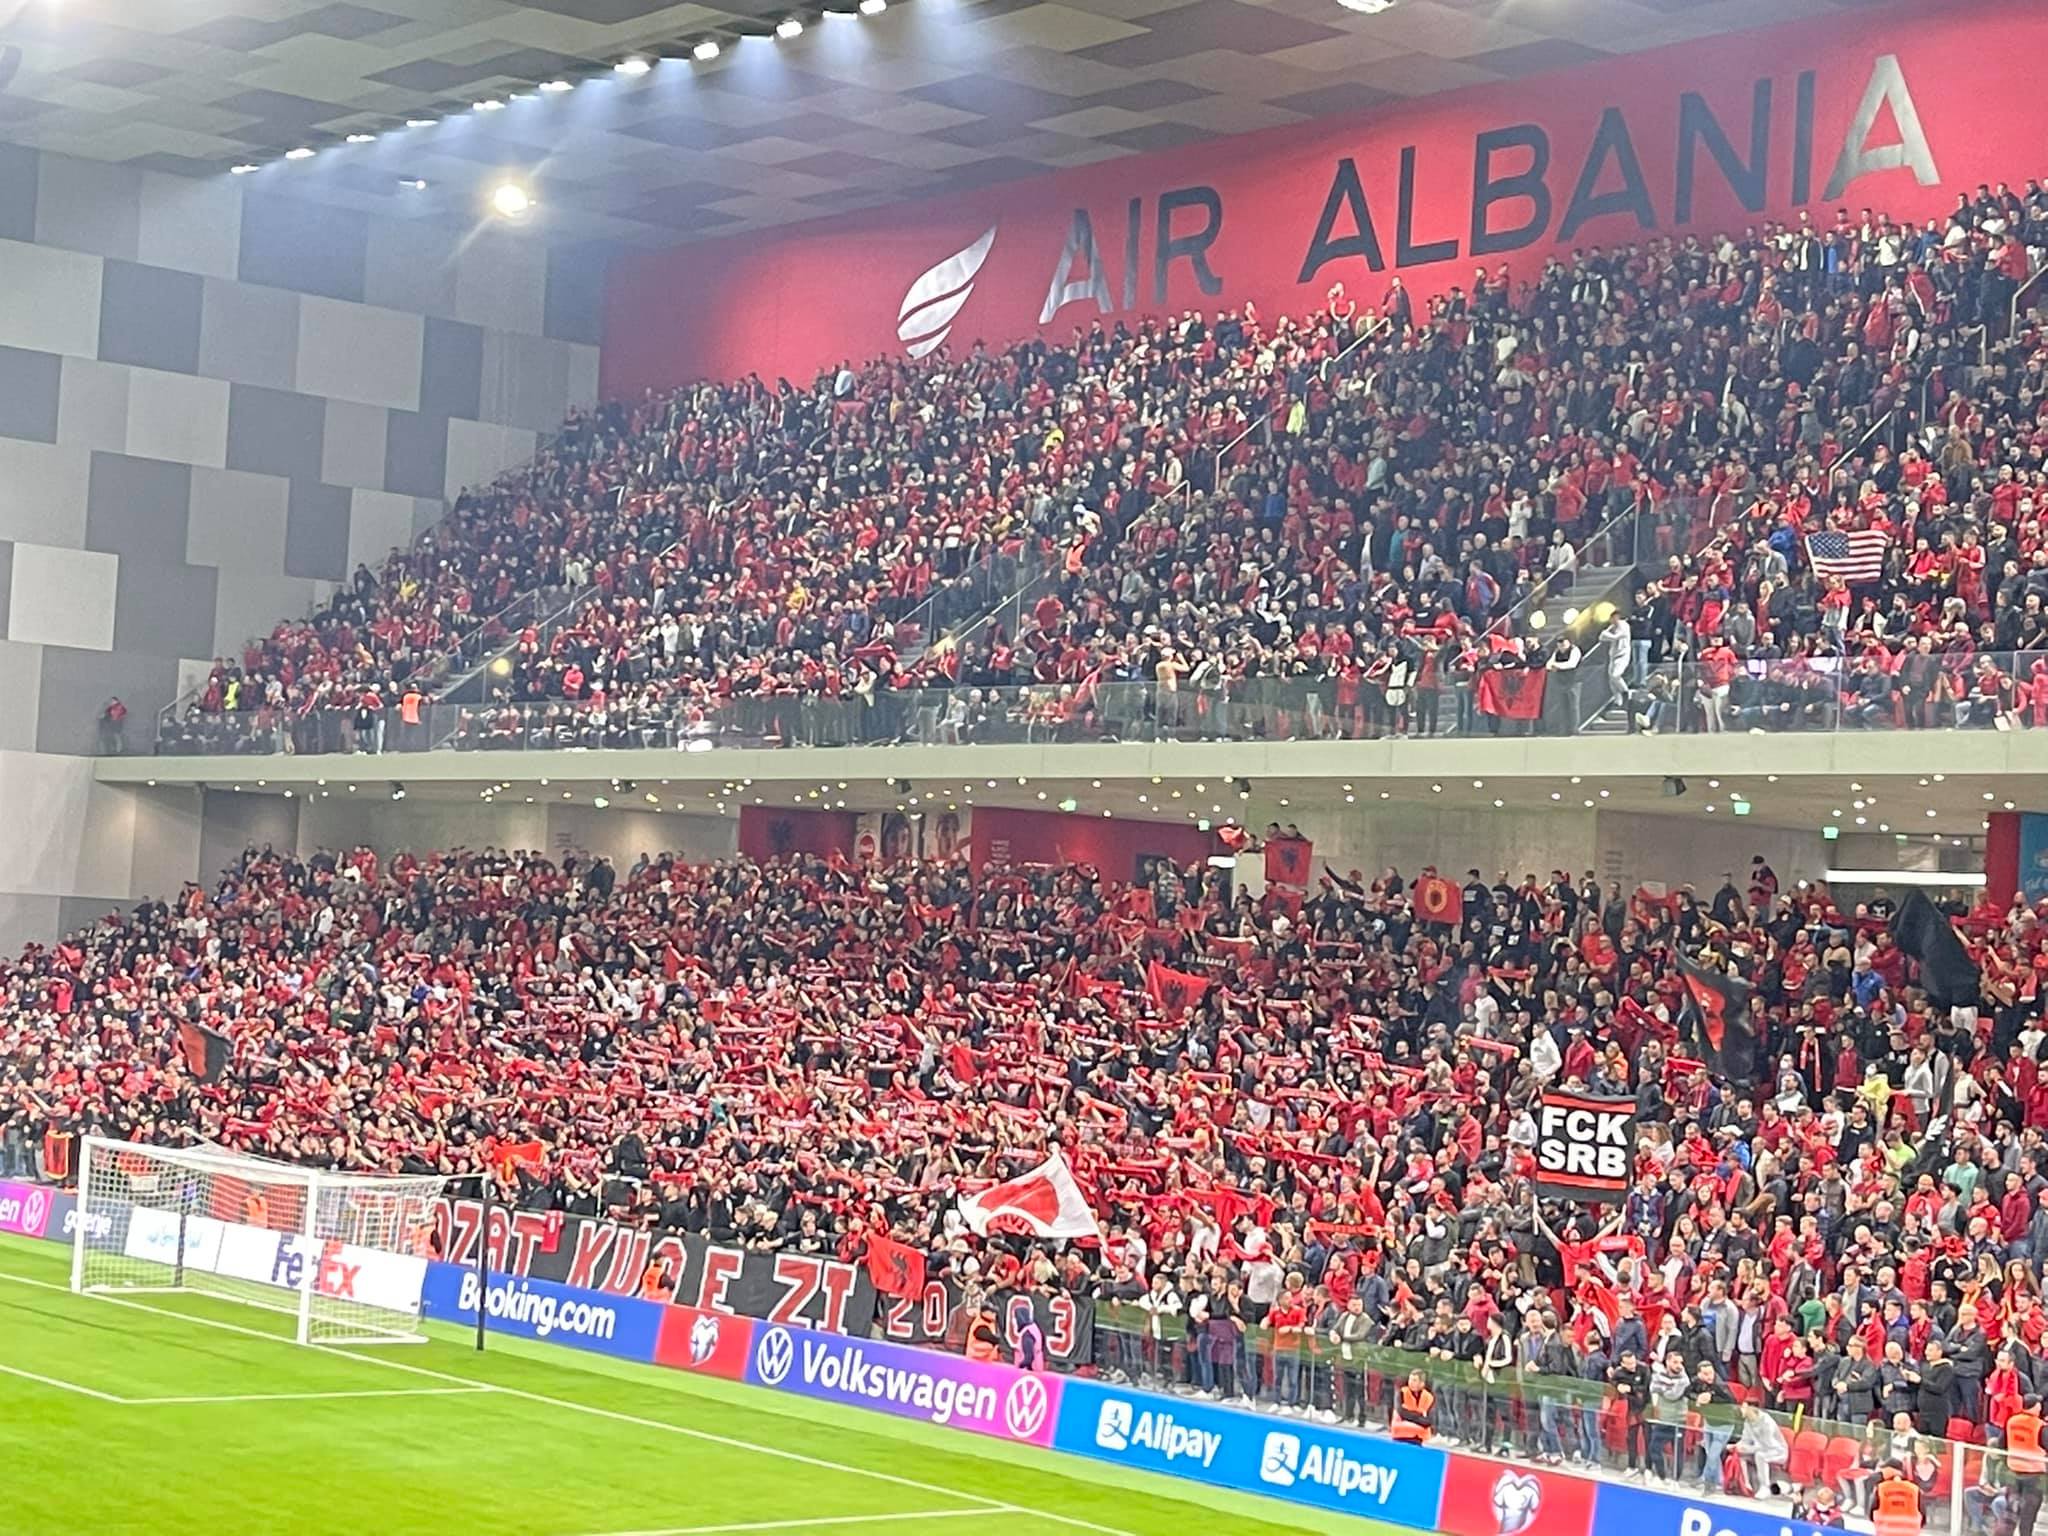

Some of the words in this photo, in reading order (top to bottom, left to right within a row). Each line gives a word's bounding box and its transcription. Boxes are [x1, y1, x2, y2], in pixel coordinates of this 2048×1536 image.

[1038, 186, 1223, 326] AIR
[1297, 53, 1941, 284] ALBANIA
[1539, 1138, 1627, 1177] SRB
[1541, 1105, 1631, 1146] FCK
[458, 1271, 616, 1340] Booking.com
[767, 1252, 857, 1336] ZI
[801, 1340, 997, 1424] Volkswagen
[1131, 1410, 1222, 1468] Alipay
[1299, 1444, 1398, 1505] Alipay
